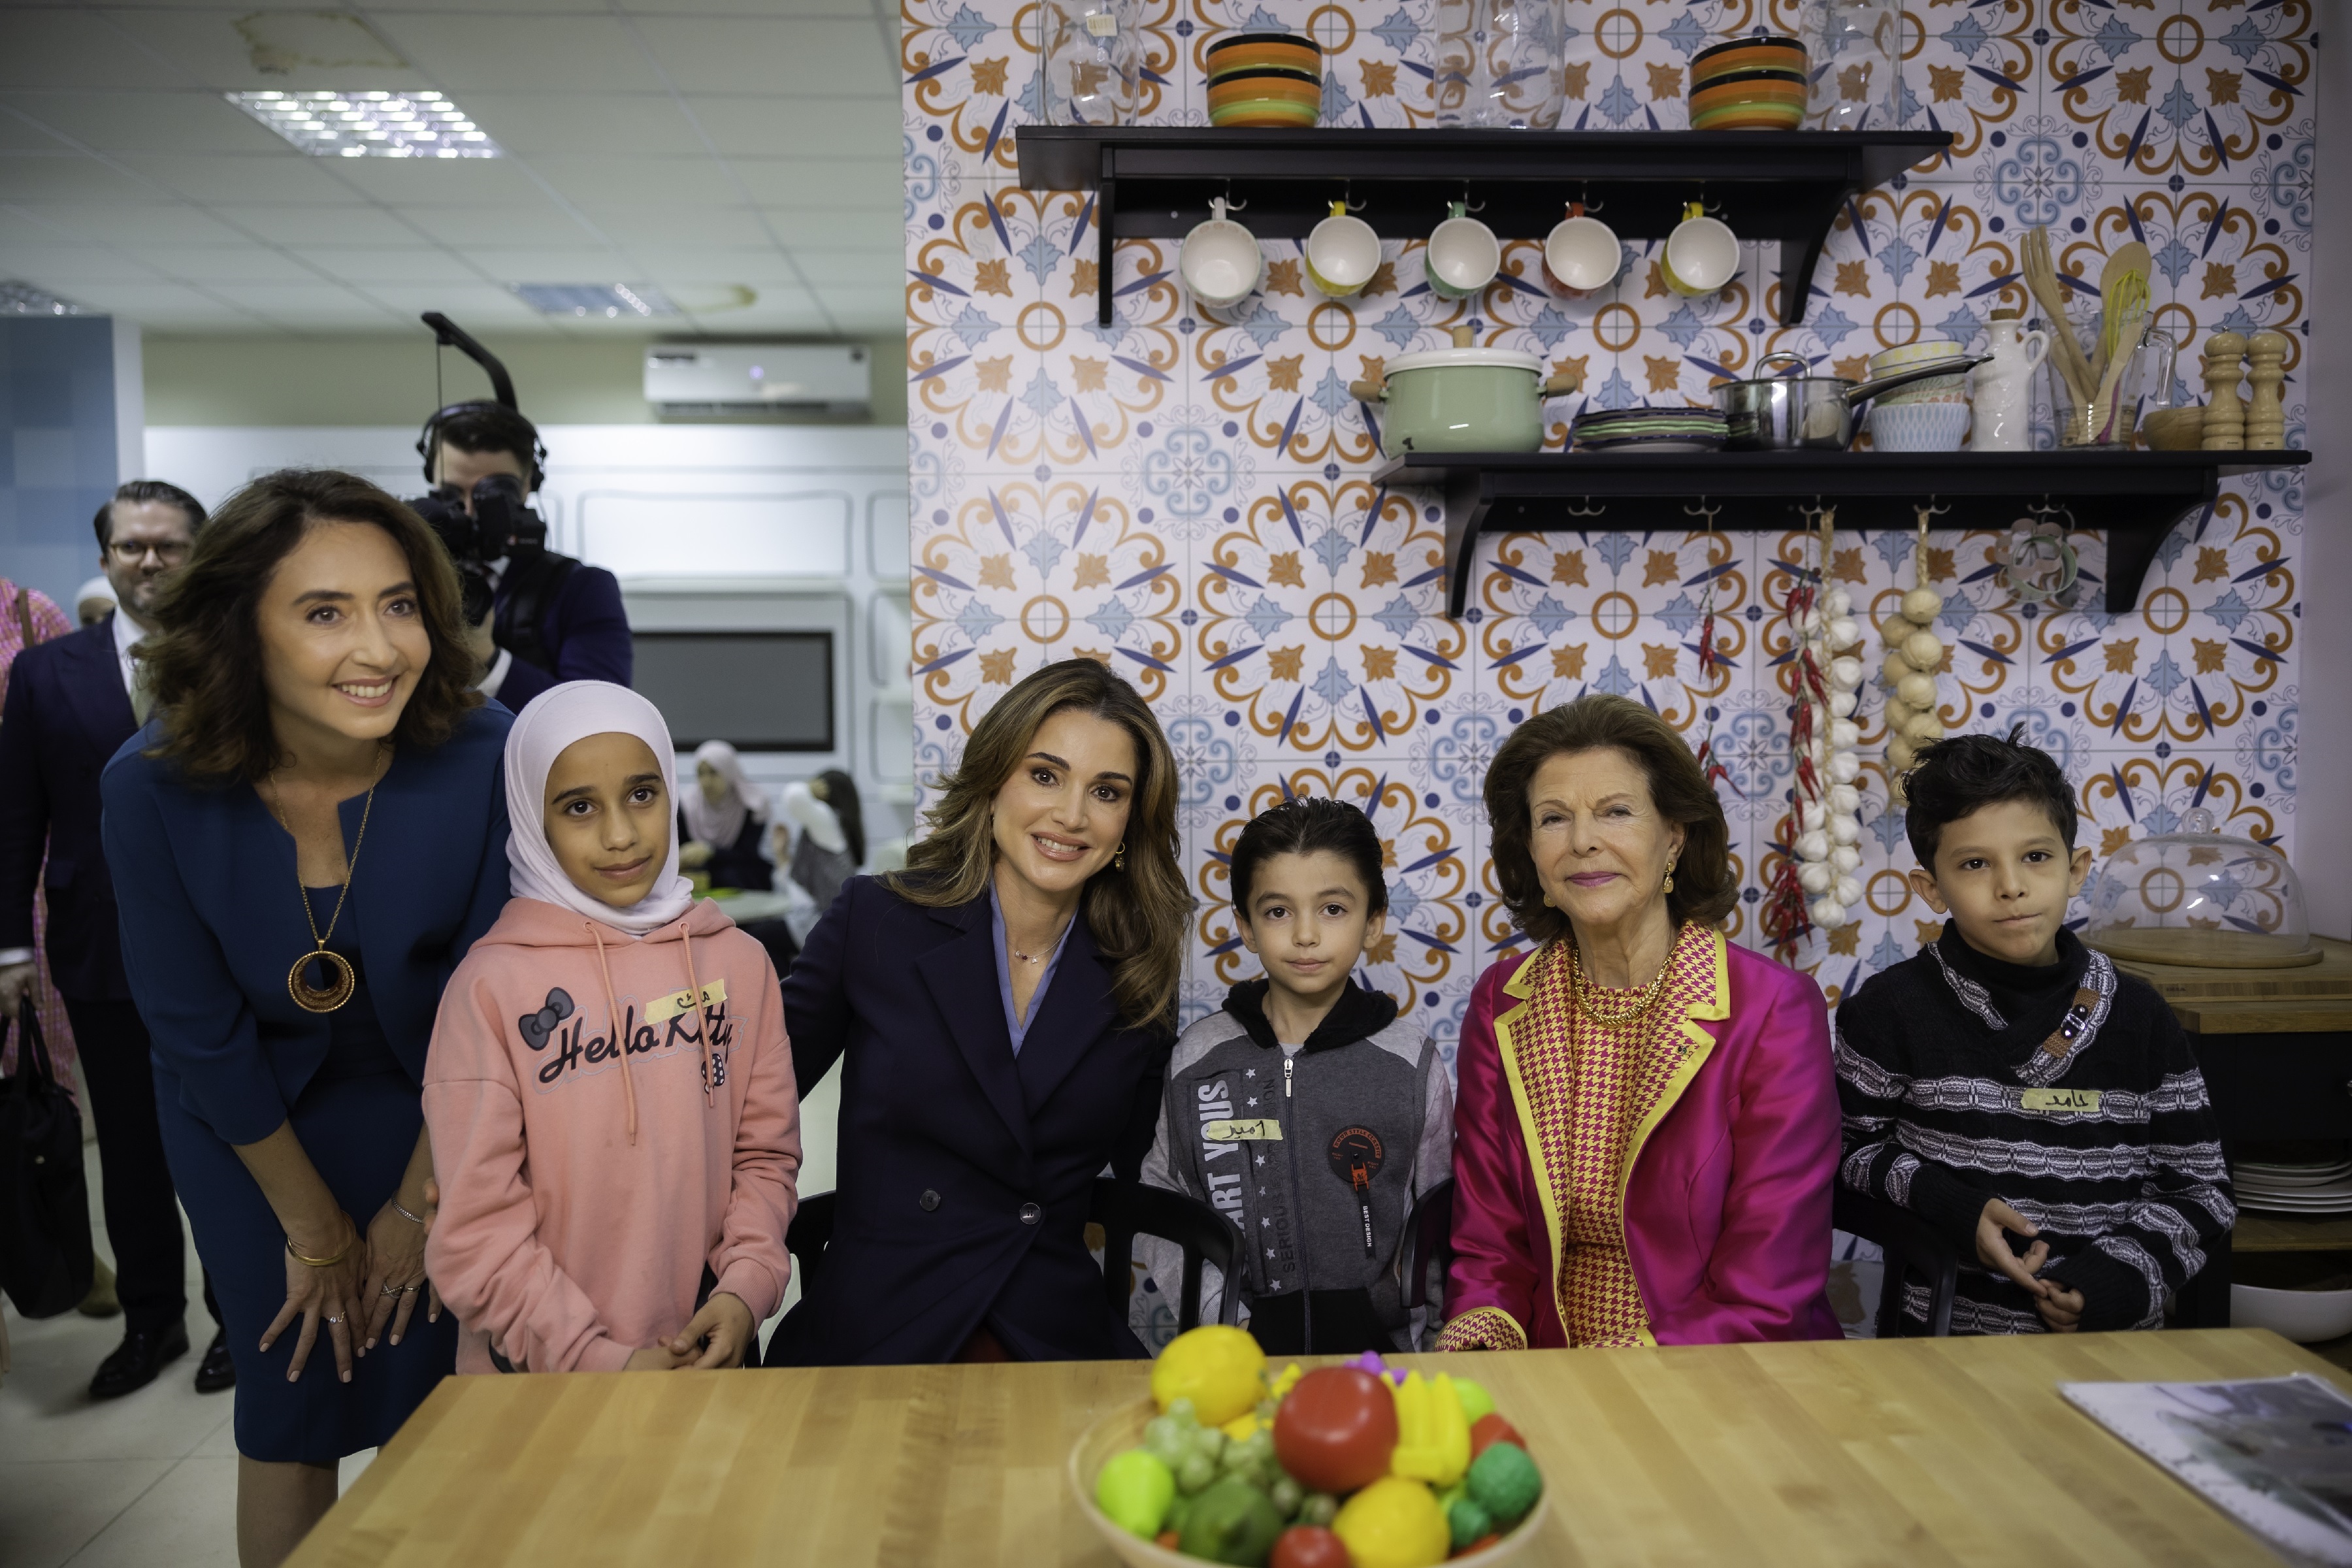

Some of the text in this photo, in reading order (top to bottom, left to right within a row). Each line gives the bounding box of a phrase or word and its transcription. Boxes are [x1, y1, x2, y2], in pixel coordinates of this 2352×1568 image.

[539, 1002, 733, 1083] Hello Ktty
[1367, 1134, 1380, 1157] CLASSIC
[1274, 1192, 1296, 1273] SERIOUS
